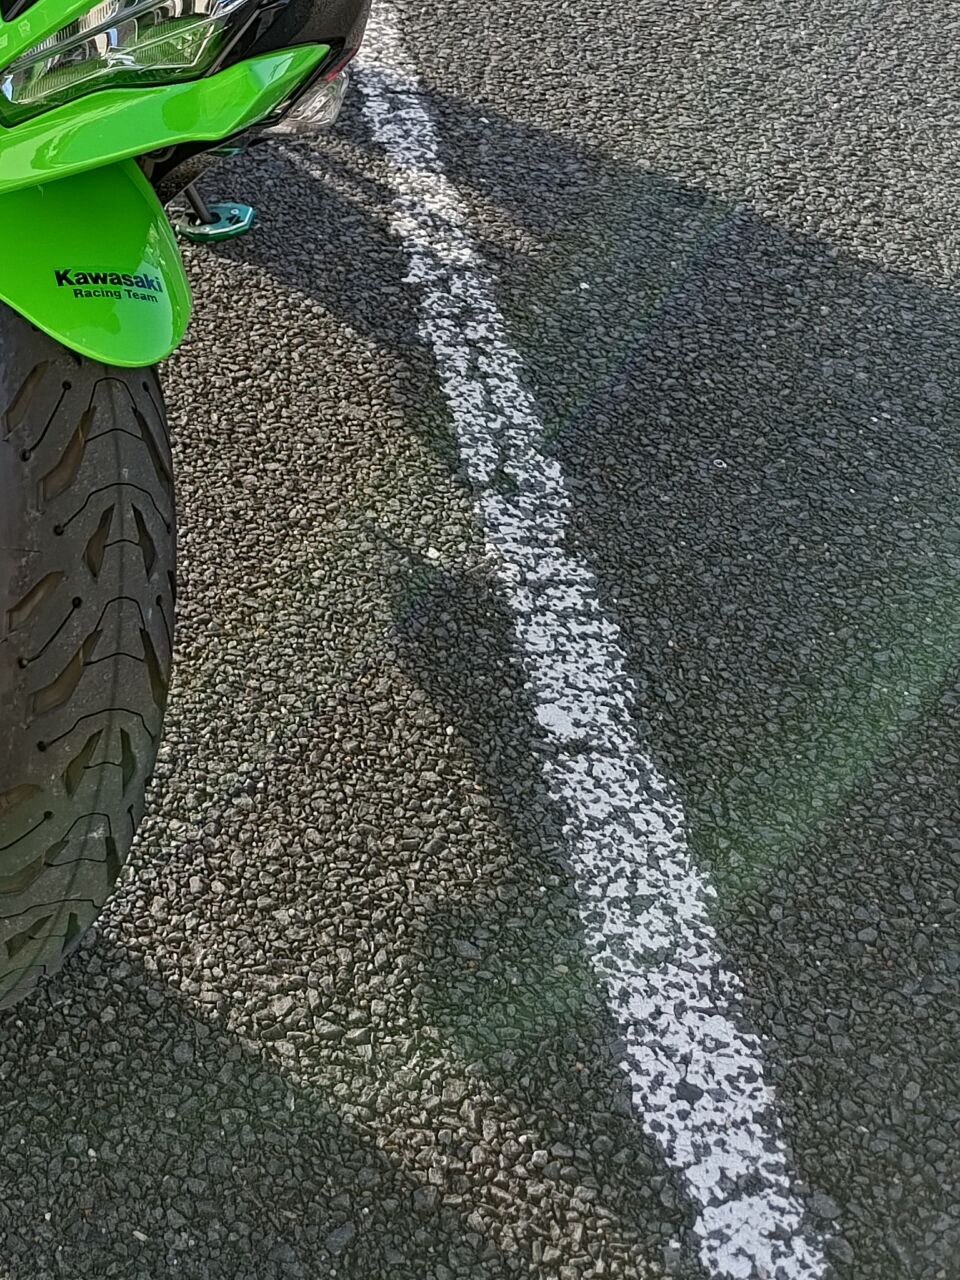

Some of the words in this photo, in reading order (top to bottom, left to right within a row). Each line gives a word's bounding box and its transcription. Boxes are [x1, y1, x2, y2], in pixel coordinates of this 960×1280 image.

[54, 268, 163, 293] Kawasaki
[73, 288, 122, 299] Racing
[124, 289, 159, 303] Team
